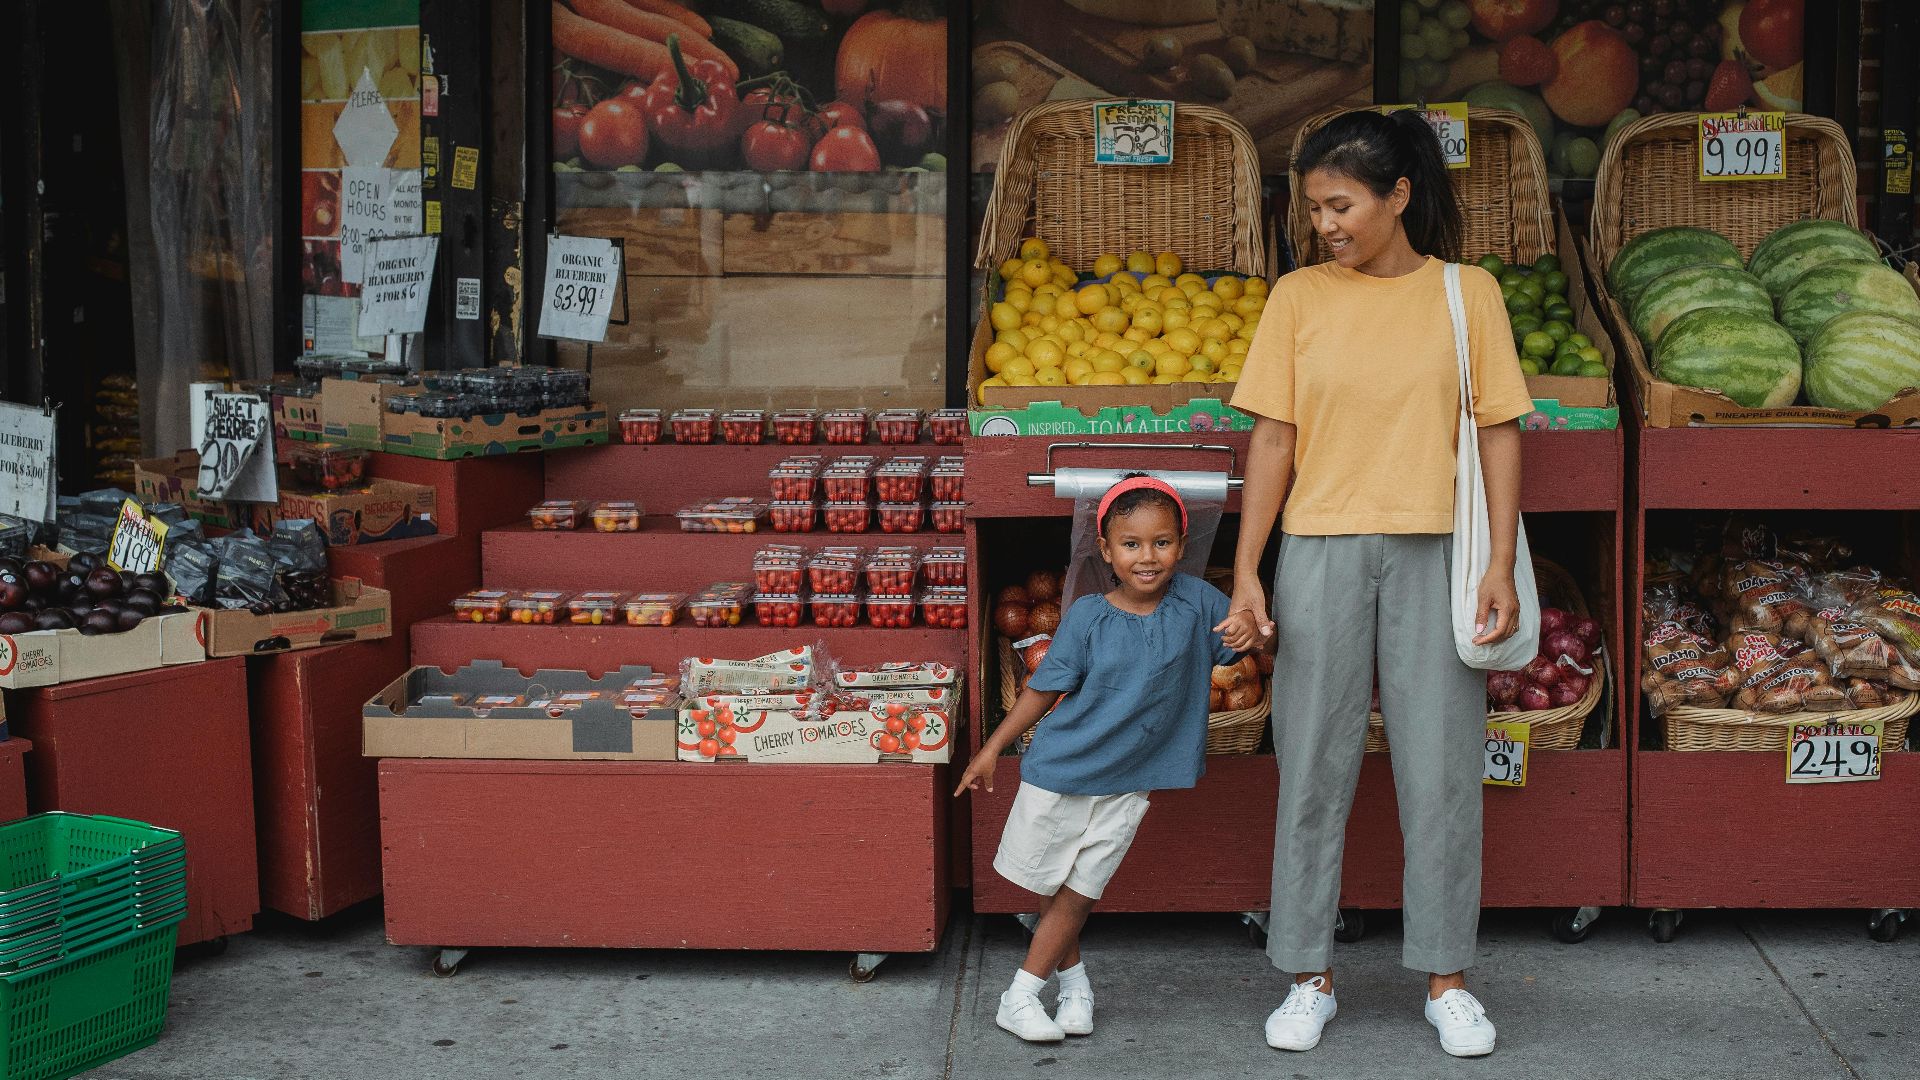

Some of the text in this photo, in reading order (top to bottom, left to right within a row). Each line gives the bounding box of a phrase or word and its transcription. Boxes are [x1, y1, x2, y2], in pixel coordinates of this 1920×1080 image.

[351, 90, 382, 108] PLEASE
[1104, 104, 1157, 116] FRESH
[1104, 115, 1157, 125] LEMON
[1706, 138, 1768, 176] 9.99
[349, 180, 380, 200] OPEN
[396, 185, 405, 193] ALL
[347, 199, 386, 221] HOURS
[378, 256, 419, 271] ORGANIC
[561, 253, 604, 268] ORGANIC
[368, 270, 426, 287] BLACKBERRY
[555, 268, 608, 283] BLUEBERRY
[375, 292, 380, 303] 2
[383, 290, 400, 302] FOR
[553, 283, 597, 314] $3.99
[213, 396, 260, 419] SWEET
[1715, 411, 1773, 419] PINEAPPLE
[0, 432, 44, 452] LUEBERRY
[0, 459, 18, 474] FOR
[197, 440, 252, 496] 3.0
[112, 530, 151, 573] $1.99
[1738, 576, 1781, 593] IDAH
[16, 655, 54, 671] TOMATOES
[21, 648, 44, 661] CHERRY
[1653, 648, 1699, 670] IDAHO
[872, 672, 920, 682] CHERRY TOMATOES
[754, 696, 783, 705] TOMATOES
[753, 717, 868, 752] CHERRY TOMATOES
[1792, 740, 1881, 777] 2.49 BAG
